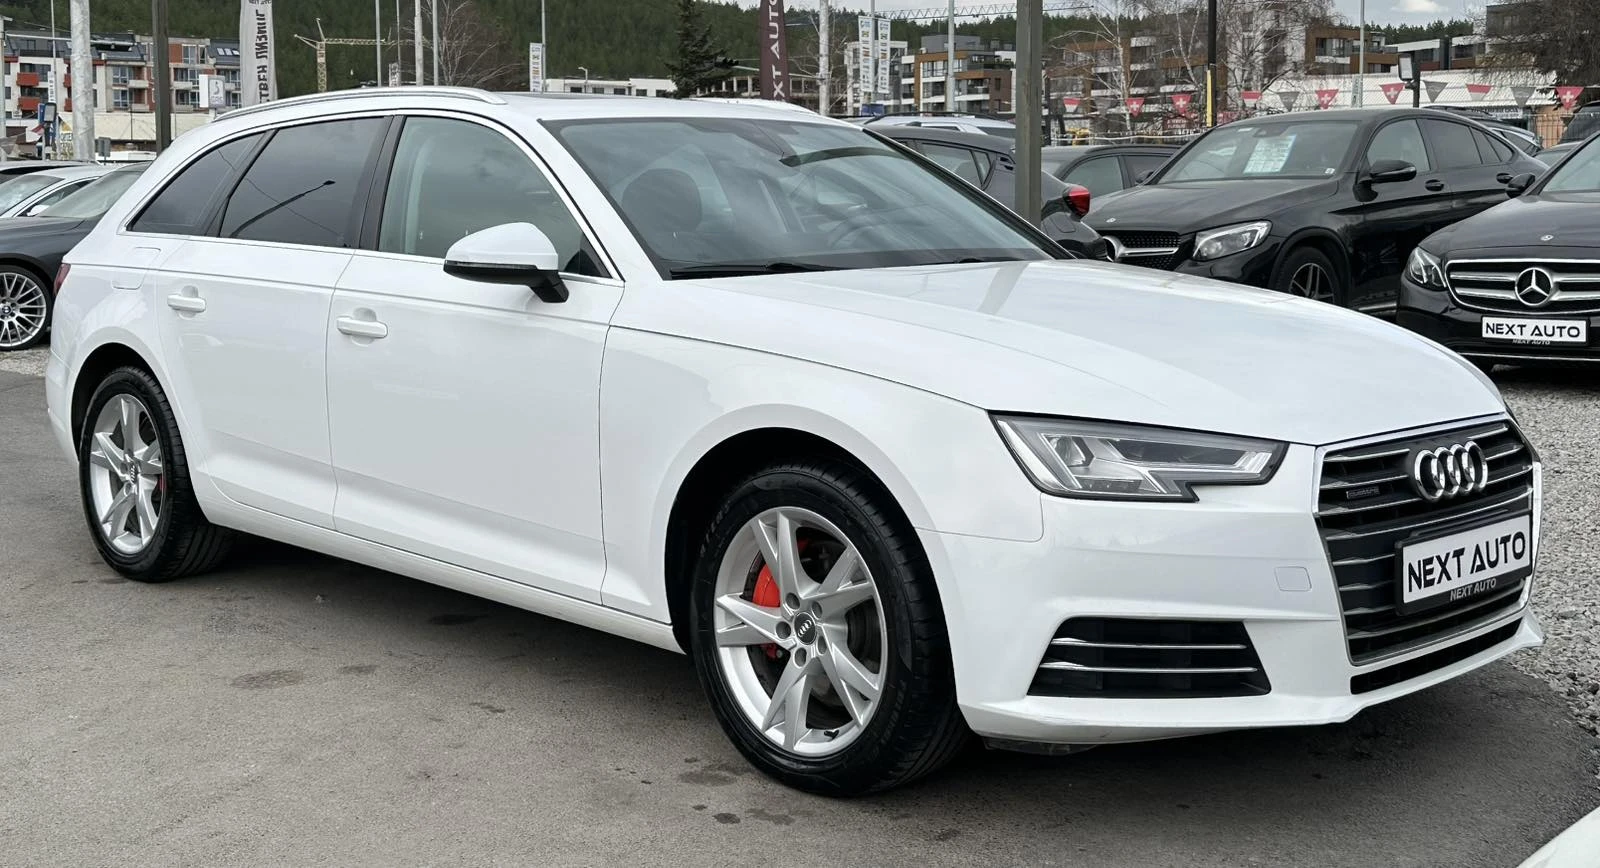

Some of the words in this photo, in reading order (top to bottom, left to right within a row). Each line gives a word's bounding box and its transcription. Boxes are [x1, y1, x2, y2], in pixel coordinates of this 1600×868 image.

[772, 64, 786, 99] XT
[1486, 322, 1527, 336] NEXT
[1530, 325, 1580, 338] AUTO
[1408, 547, 1466, 593] NEXT
[1469, 531, 1526, 575] AUTO
[1450, 584, 1474, 602] NEXT
[1473, 577, 1497, 594] AUTO
